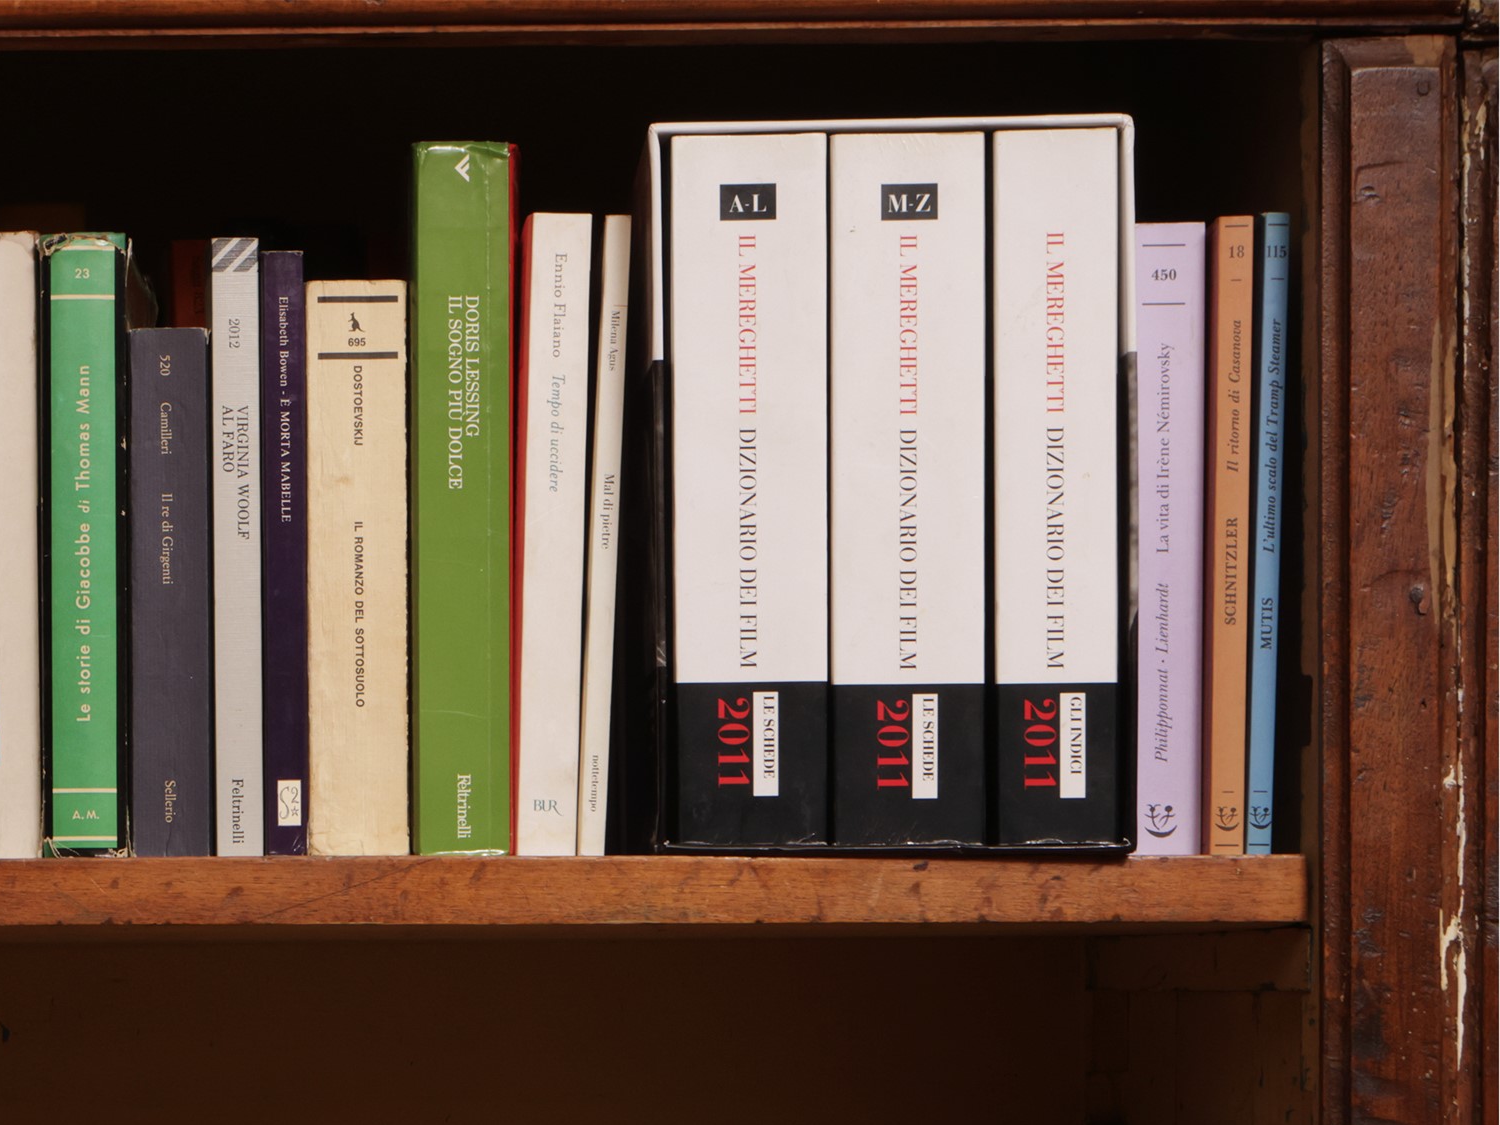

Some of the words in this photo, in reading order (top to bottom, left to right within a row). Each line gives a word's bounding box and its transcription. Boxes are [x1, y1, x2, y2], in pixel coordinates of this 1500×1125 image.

[729, 194, 766, 213] A-L
[888, 194, 931, 212] M-Z
[75, 267, 90, 279] 23
[900, 236, 917, 256] IL
[1151, 269, 1176, 280] 450
[449, 296, 462, 313] IL
[466, 296, 479, 352] DORIS
[160, 355, 170, 376] 520
[448, 319, 462, 383] SOGNO
[900, 265, 917, 415] MEREGHETTI
[77, 366, 90, 414] Mann
[354, 366, 363, 445] DOSTOEVSKIJ
[449, 389, 466, 421] PIÙ
[466, 358, 479, 437] LESSING
[160, 402, 172, 454] Camilleri
[237, 406, 249, 478] VIRGINIA
[75, 424, 90, 491] Thomas
[449, 427, 462, 489] DOLCE
[604, 474, 614, 495] Mal
[237, 484, 249, 539] WOOLF
[603, 499, 614, 510] di
[899, 428, 918, 562] DIZIONARIO
[600, 514, 613, 549] pietre
[899, 569, 917, 609] DEI
[1224, 518, 1237, 625] SCHNITZLER
[900, 616, 917, 670] FILM
[923, 698, 934, 716] LE
[718, 698, 750, 788] 2011
[877, 700, 909, 791] 2011
[923, 721, 934, 781] SCHEDE
[1024, 698, 1057, 790] 2011
